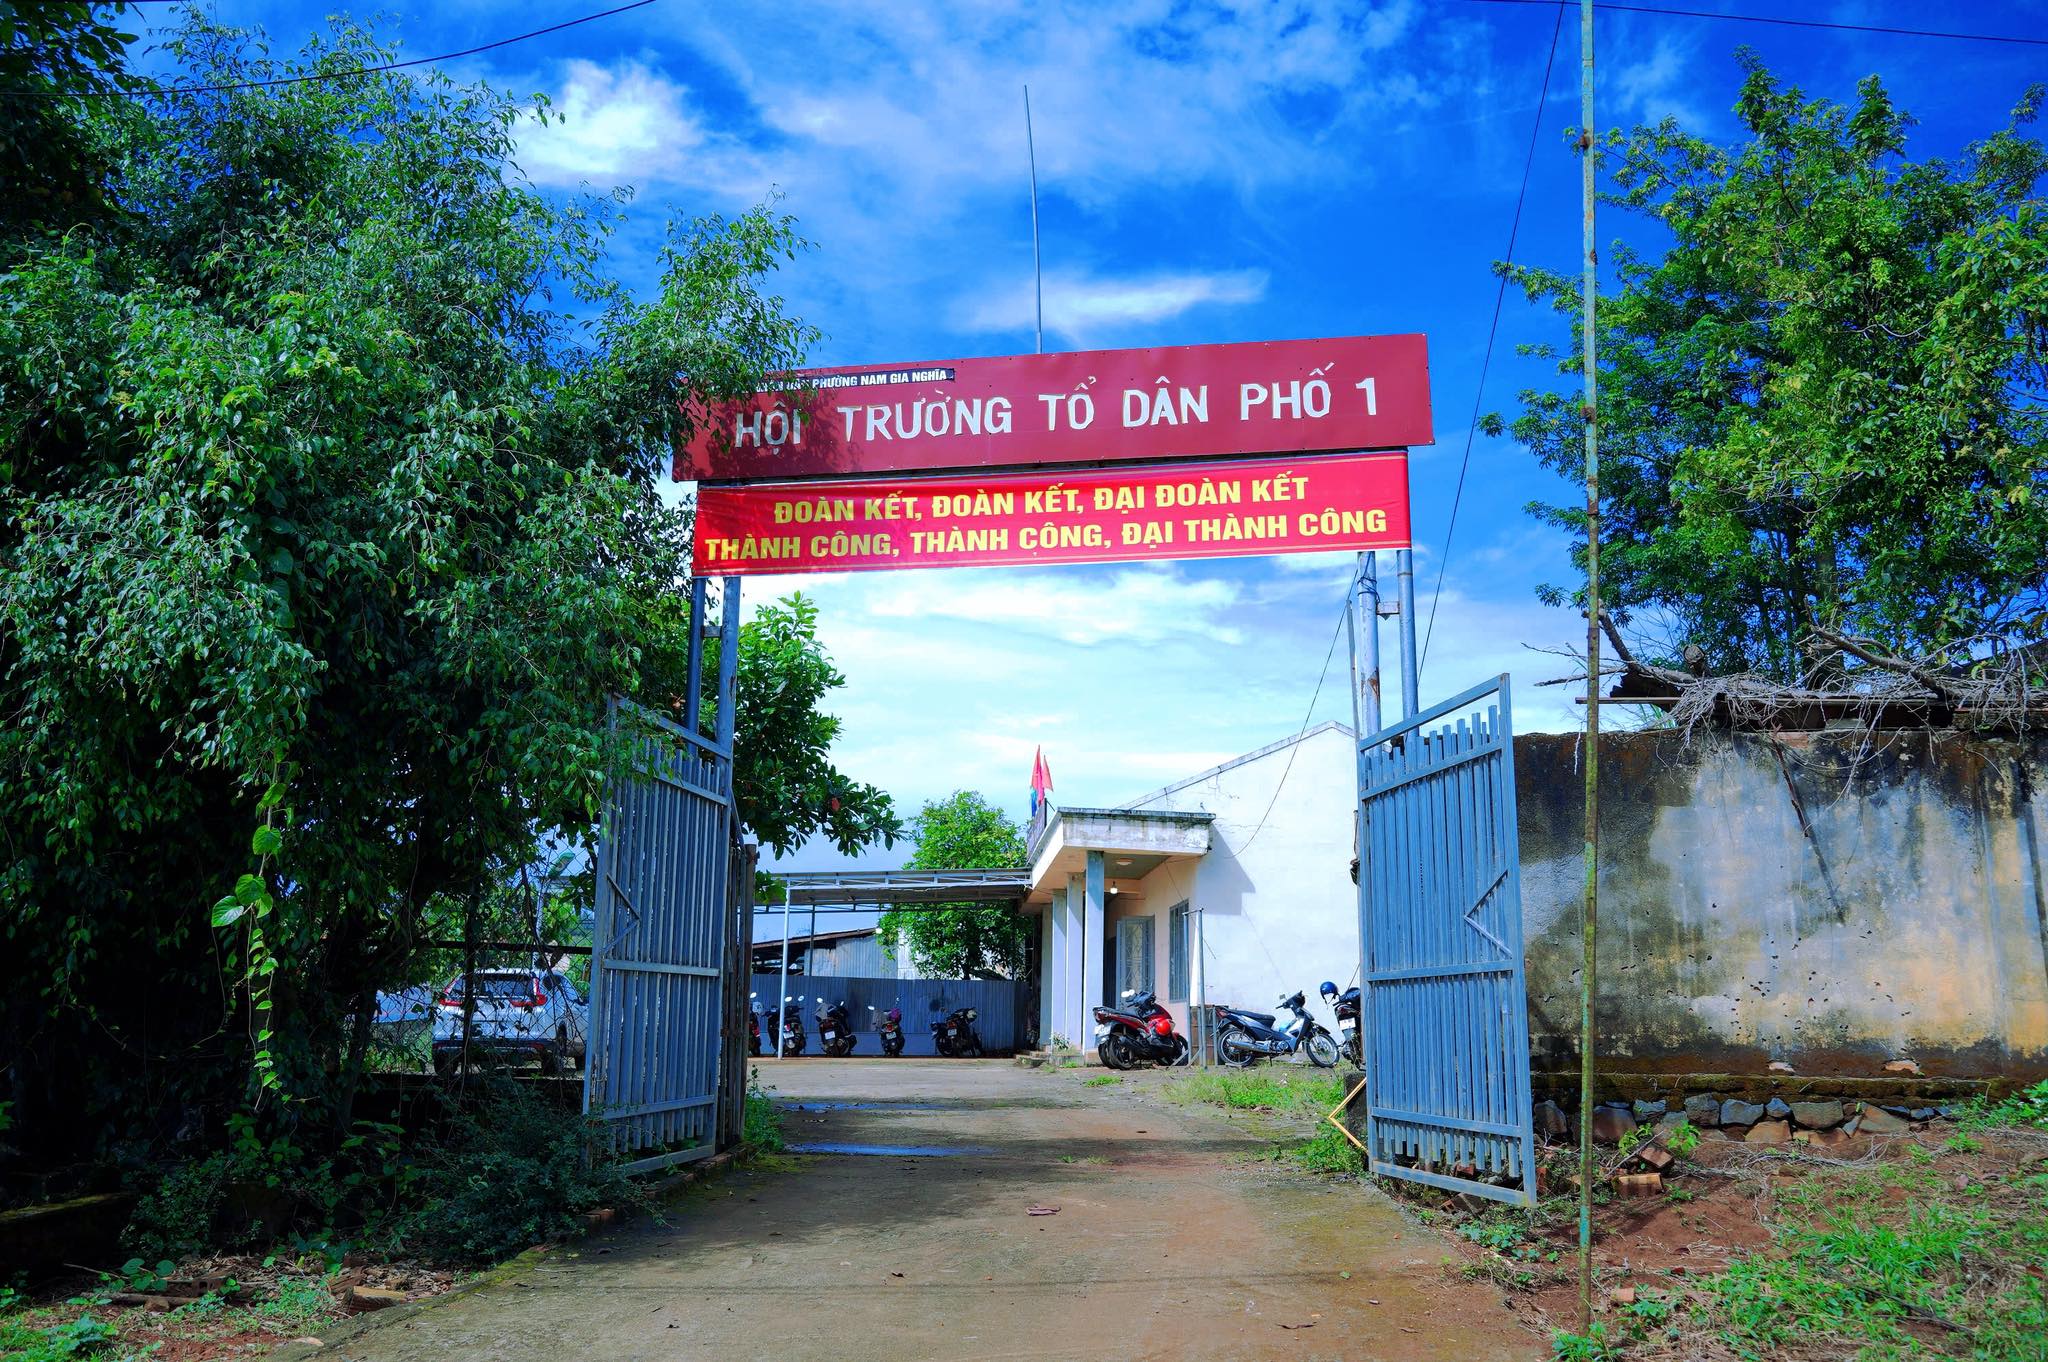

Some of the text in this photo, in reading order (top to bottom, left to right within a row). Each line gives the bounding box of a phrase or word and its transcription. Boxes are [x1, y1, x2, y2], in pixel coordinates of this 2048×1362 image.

[812, 374, 858, 389] PHƯỜNG
[860, 373, 887, 386] NAM
[889, 371, 909, 384] GIA
[911, 368, 947, 382] NGHĨA
[734, 362, 1377, 455] HỘI TRƯỜNG TỔ DÂN PHỐ 1
[774, 470, 1309, 524] ĐOÀN KẾT, ĐOÀN KẾT, ĐẠI ĐOÀN KẾT
[705, 507, 1387, 561] THÀNH CÔNG, THÀNH CÔNG, ĐẠI THÀNH CÔNG
